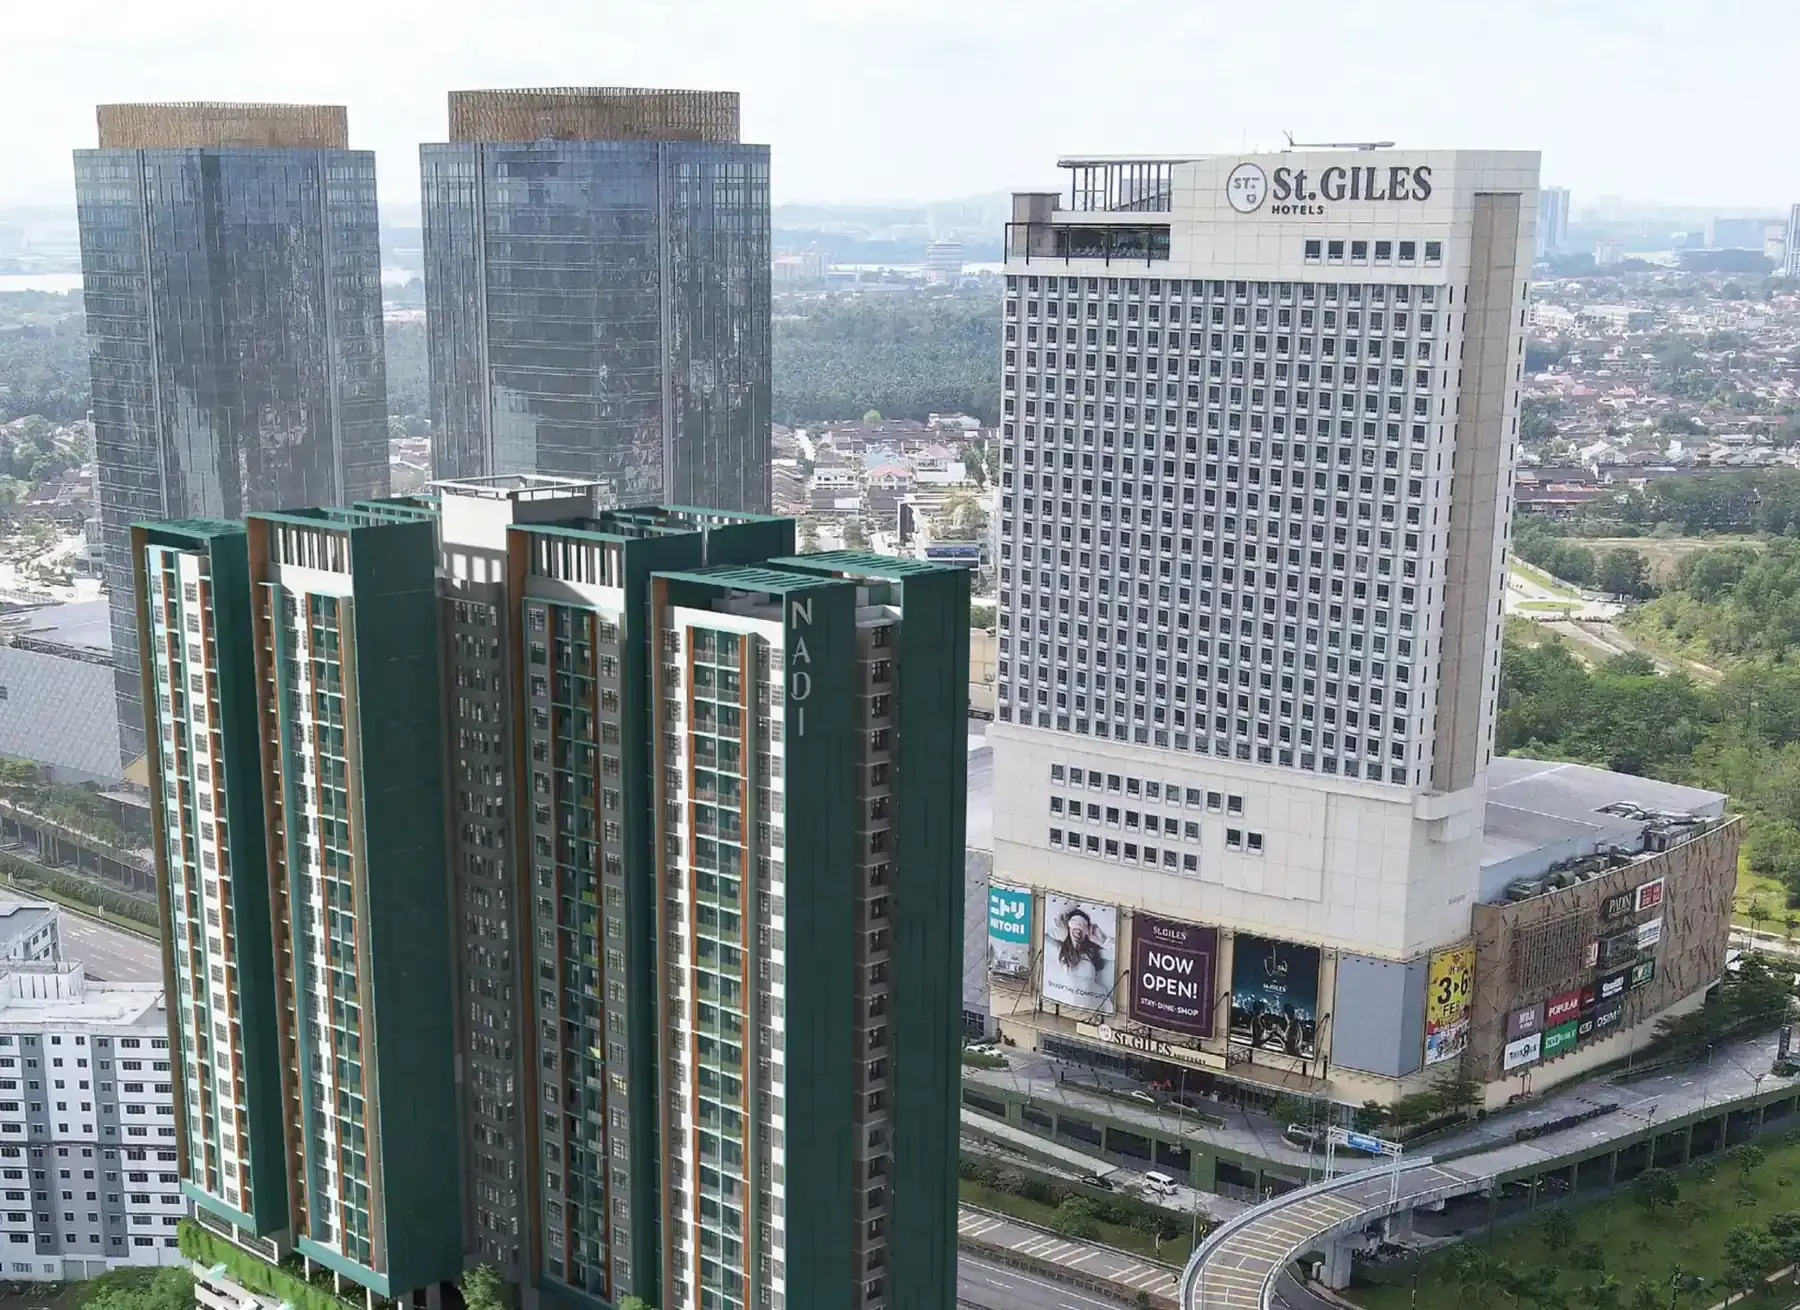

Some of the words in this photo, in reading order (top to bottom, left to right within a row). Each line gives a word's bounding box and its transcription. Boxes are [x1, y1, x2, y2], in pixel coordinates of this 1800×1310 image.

[1272, 205, 1324, 215] HOTELS
[791, 598, 812, 737] NADI
[991, 895, 1025, 920] ニトリ
[1148, 950, 1194, 975] NOW
[1142, 972, 1198, 999] OPEN!
[1548, 998, 1578, 1017] POPULAR
